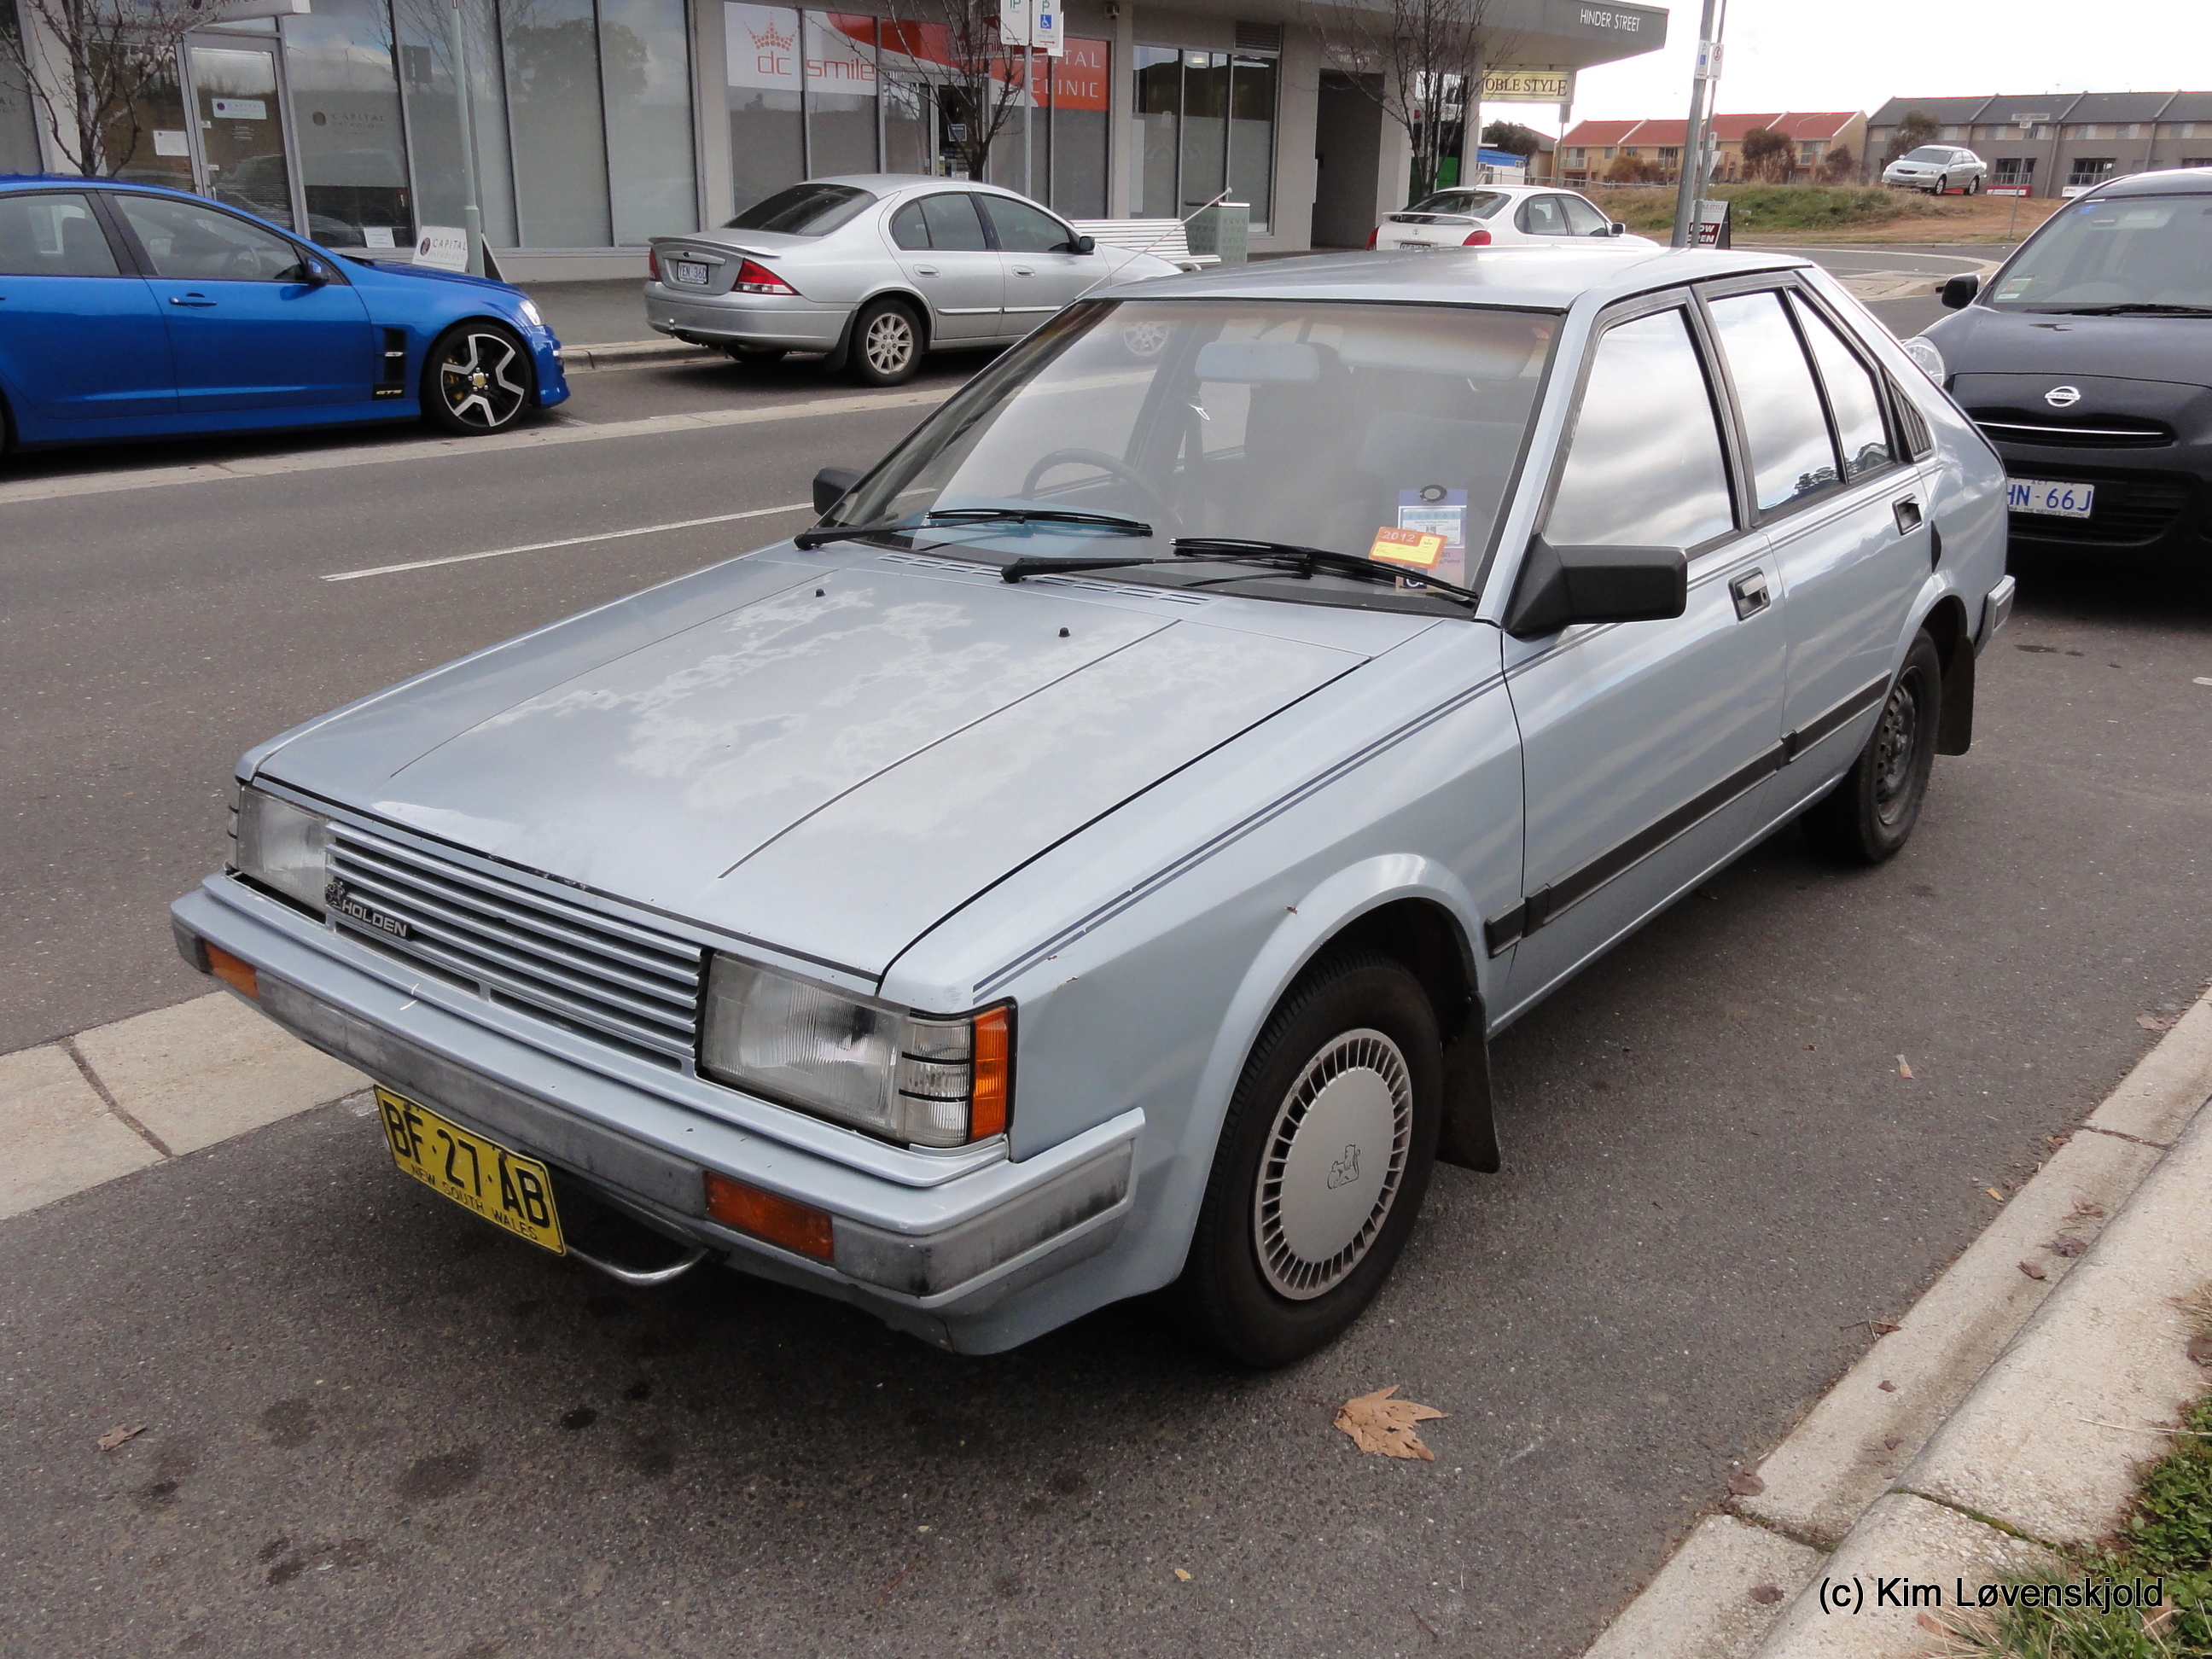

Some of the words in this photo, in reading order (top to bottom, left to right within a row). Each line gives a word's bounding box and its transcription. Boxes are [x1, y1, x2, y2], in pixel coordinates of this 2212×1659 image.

[1580, 9, 1611, 27] HINDER
[1614, 14, 1640, 32] STREET
[757, 50, 792, 76] dc
[806, 58, 876, 82] smile
[1523, 79, 1568, 96] STYLE
[433, 238, 467, 251] CAPITAL
[1382, 530, 1416, 544] 2012
[341, 899, 407, 938] HOLDEN
[410, 1162, 436, 1186] NEW
[441, 1181, 485, 1214] SOUTH
[491, 1206, 538, 1241] WALES
